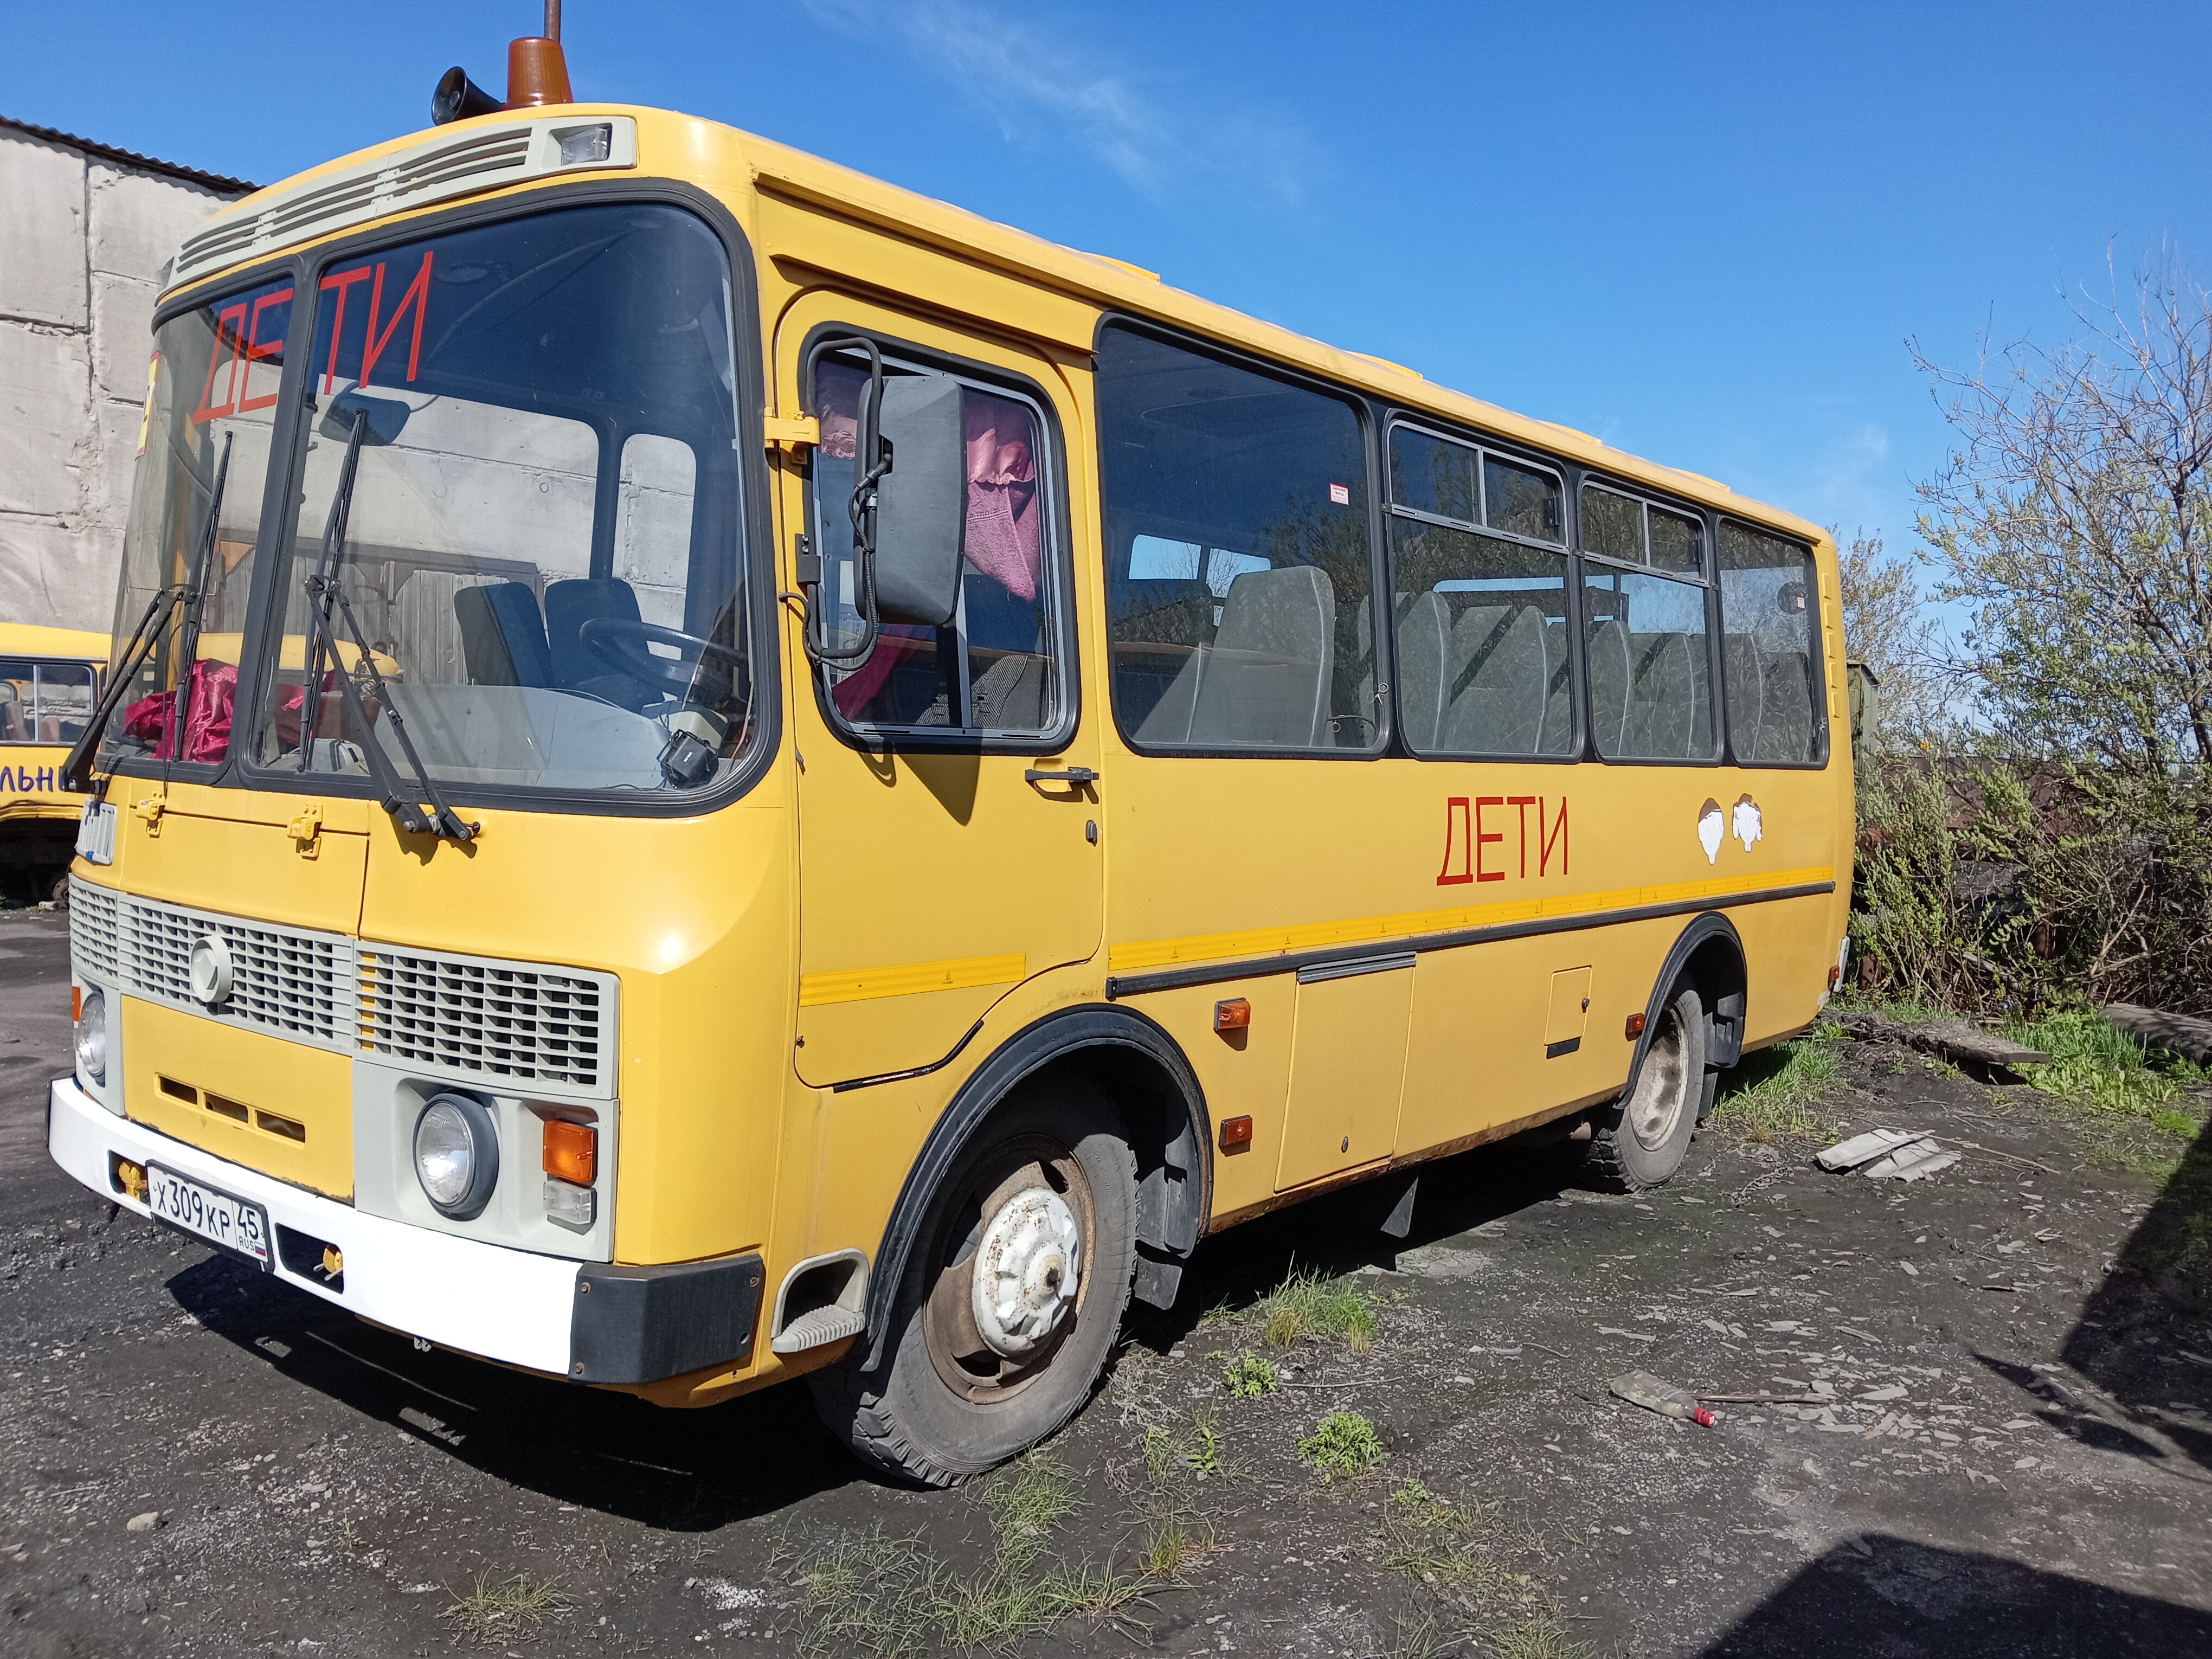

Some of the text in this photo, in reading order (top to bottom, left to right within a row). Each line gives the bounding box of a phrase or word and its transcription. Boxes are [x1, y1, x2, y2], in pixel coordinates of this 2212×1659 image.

[193, 251, 433, 423] ДЕТИ
[1436, 796, 1568, 886] ДЕТИ
[237, 1205, 259, 1240] 45
[239, 1236, 255, 1251] RUS
